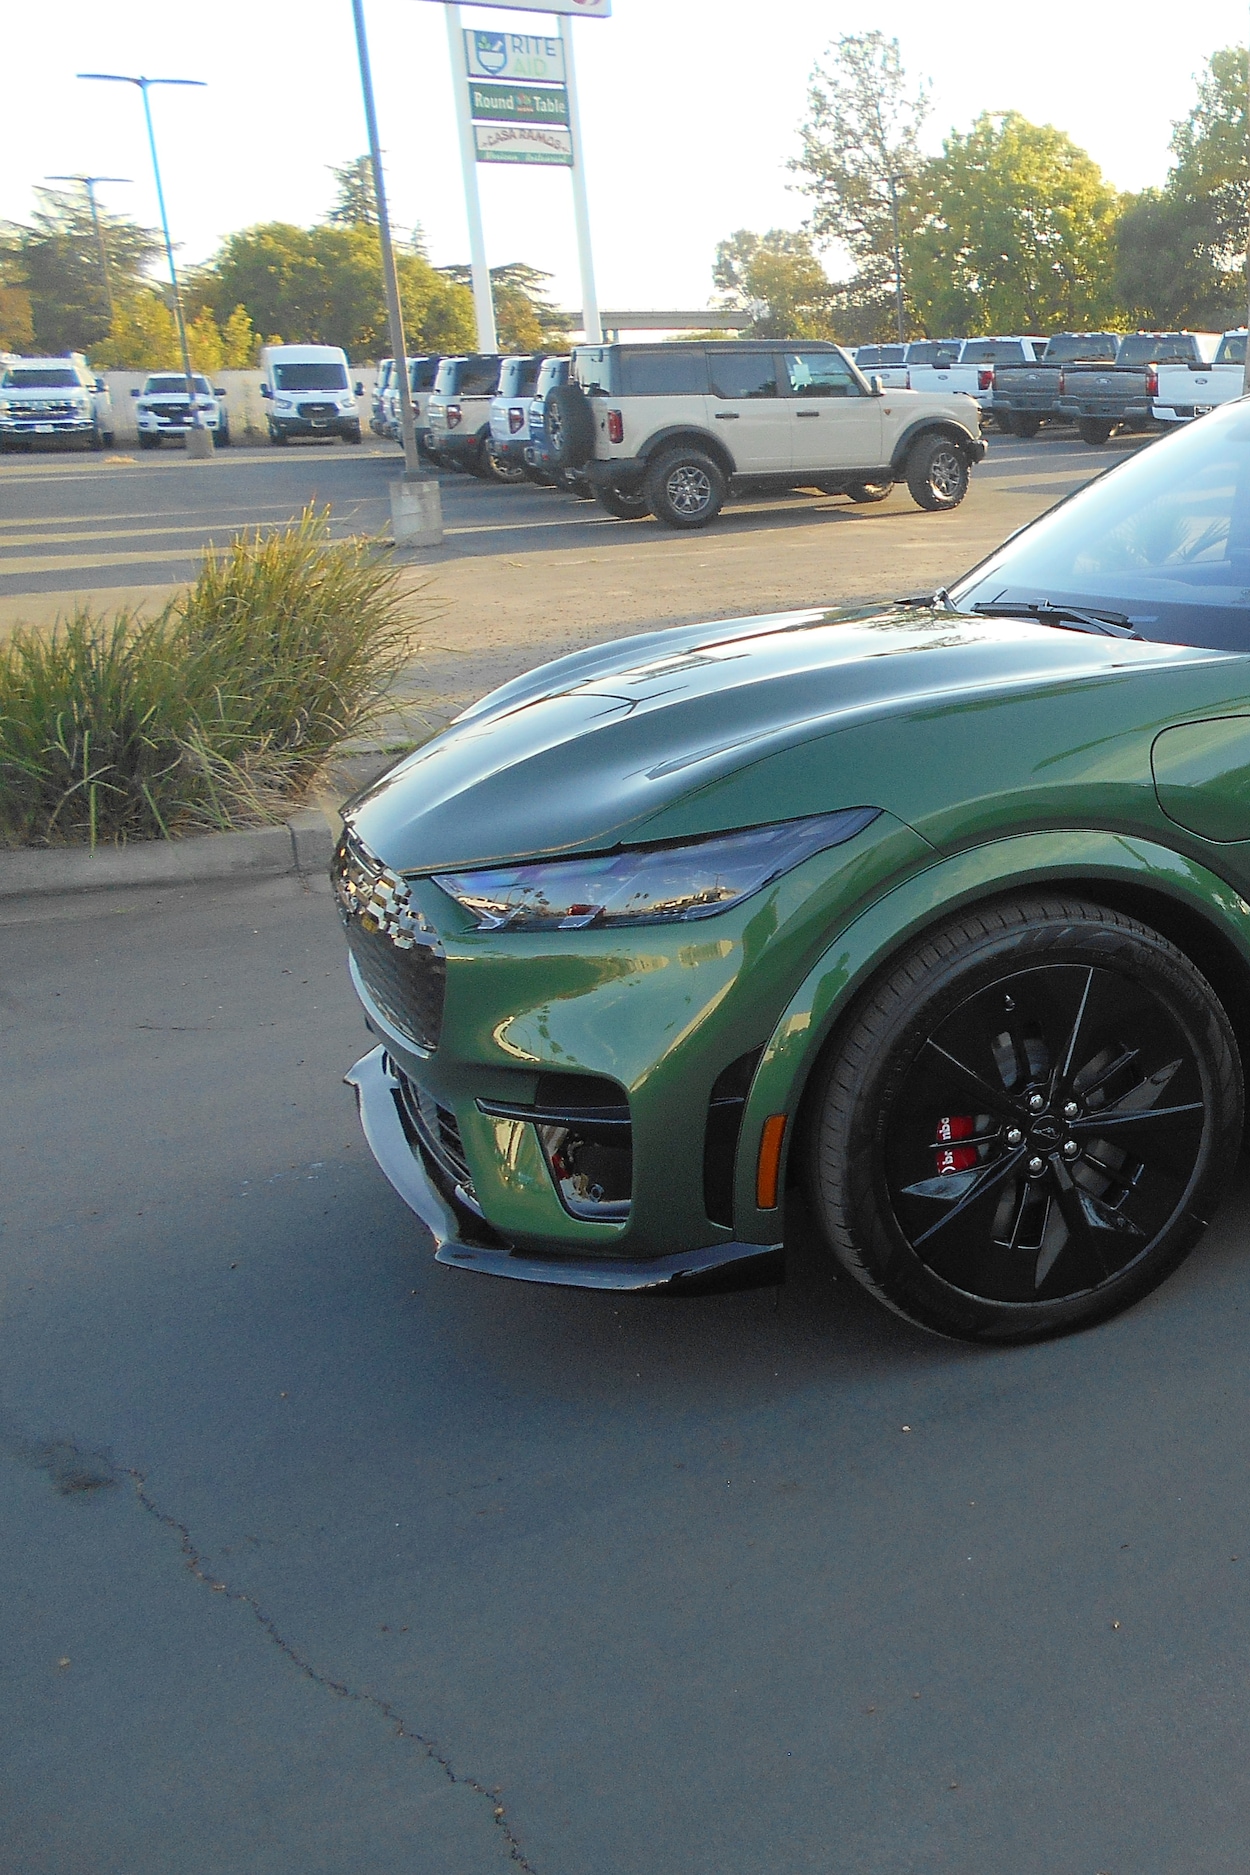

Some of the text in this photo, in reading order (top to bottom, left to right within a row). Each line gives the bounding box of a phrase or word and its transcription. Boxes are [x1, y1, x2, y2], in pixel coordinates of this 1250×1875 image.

[511, 35, 556, 56] RITE
[514, 58, 547, 76] AID
[474, 91, 566, 114] Round Table
[487, 128, 562, 150] CASA RAMOS
